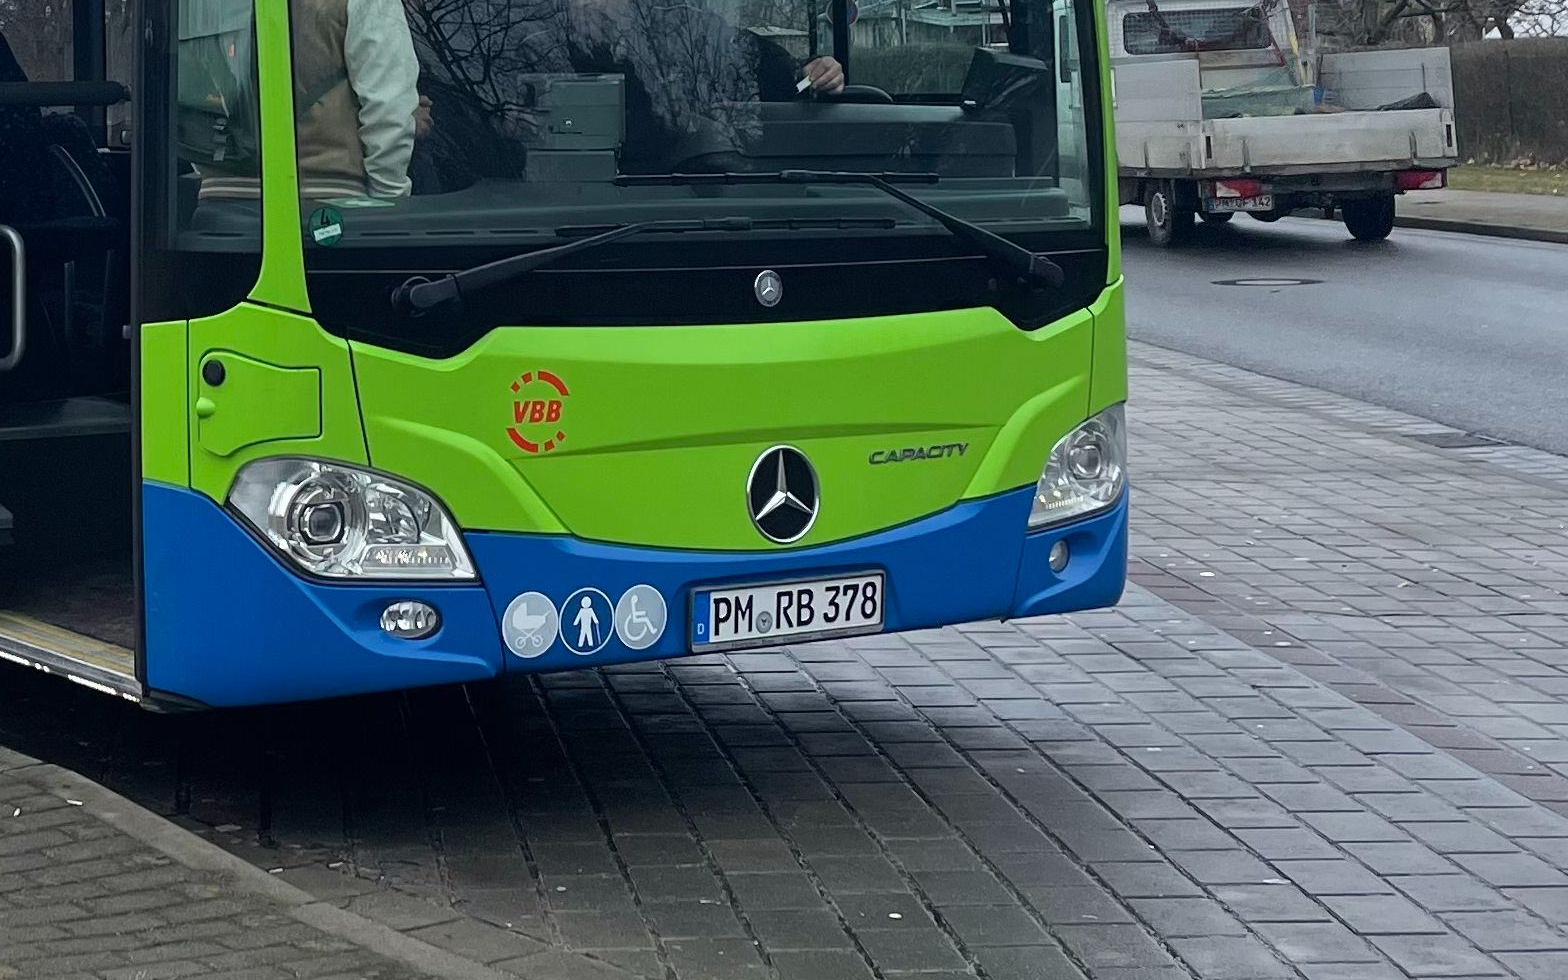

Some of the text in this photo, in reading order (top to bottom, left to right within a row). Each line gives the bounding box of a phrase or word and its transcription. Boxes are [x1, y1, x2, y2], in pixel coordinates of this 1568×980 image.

[513, 400, 563, 424] VBB
[868, 442, 969, 465] CAPACITY
[696, 581, 878, 637] D PM RB 378
